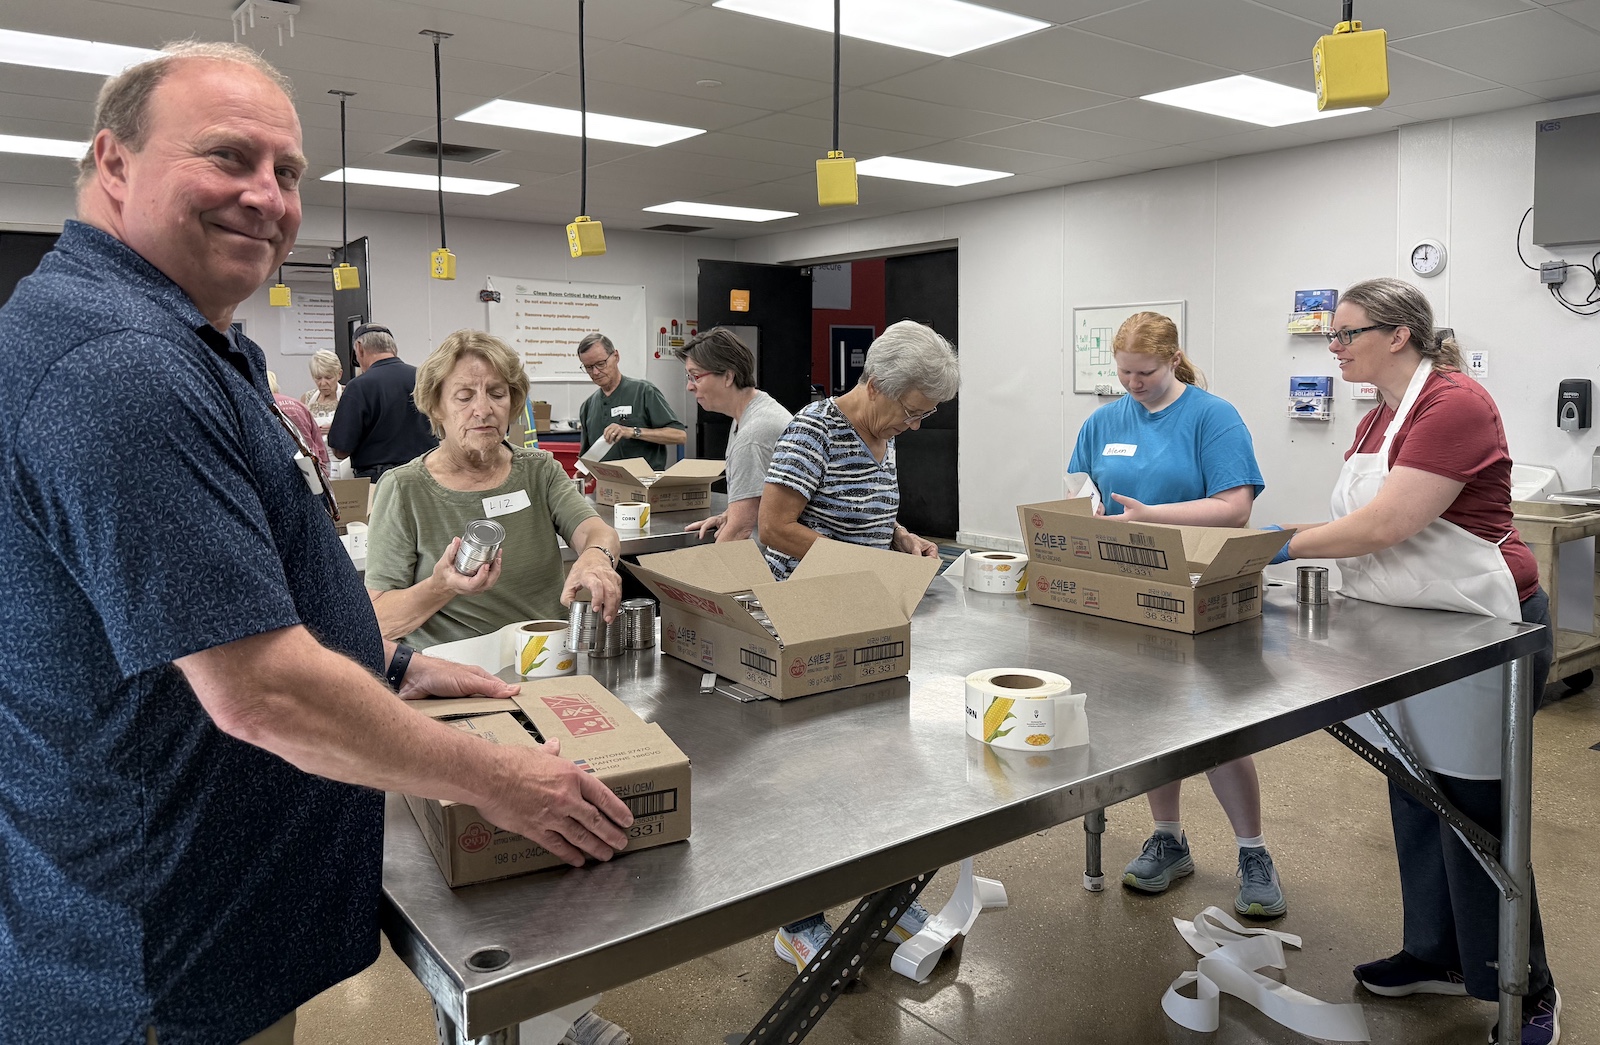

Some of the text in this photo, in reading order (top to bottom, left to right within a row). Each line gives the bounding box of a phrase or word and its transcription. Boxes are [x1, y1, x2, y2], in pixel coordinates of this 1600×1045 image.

[1034, 532, 1067, 551] 스위트콘
[1134, 568, 1152, 576] 331
[1050, 579, 1076, 594] 스위트콘
[1145, 611, 1177, 623] 36 331
[861, 664, 896, 676] 36 331
[966, 706, 978, 720] ORN
[588, 750, 627, 762] PANTONE
[592, 756, 630, 766] PANTONE
[613, 784, 630, 796] 국산
[630, 822, 662, 838] 331
[495, 852, 509, 865] 198
[791, 936, 810, 960] HOKA
